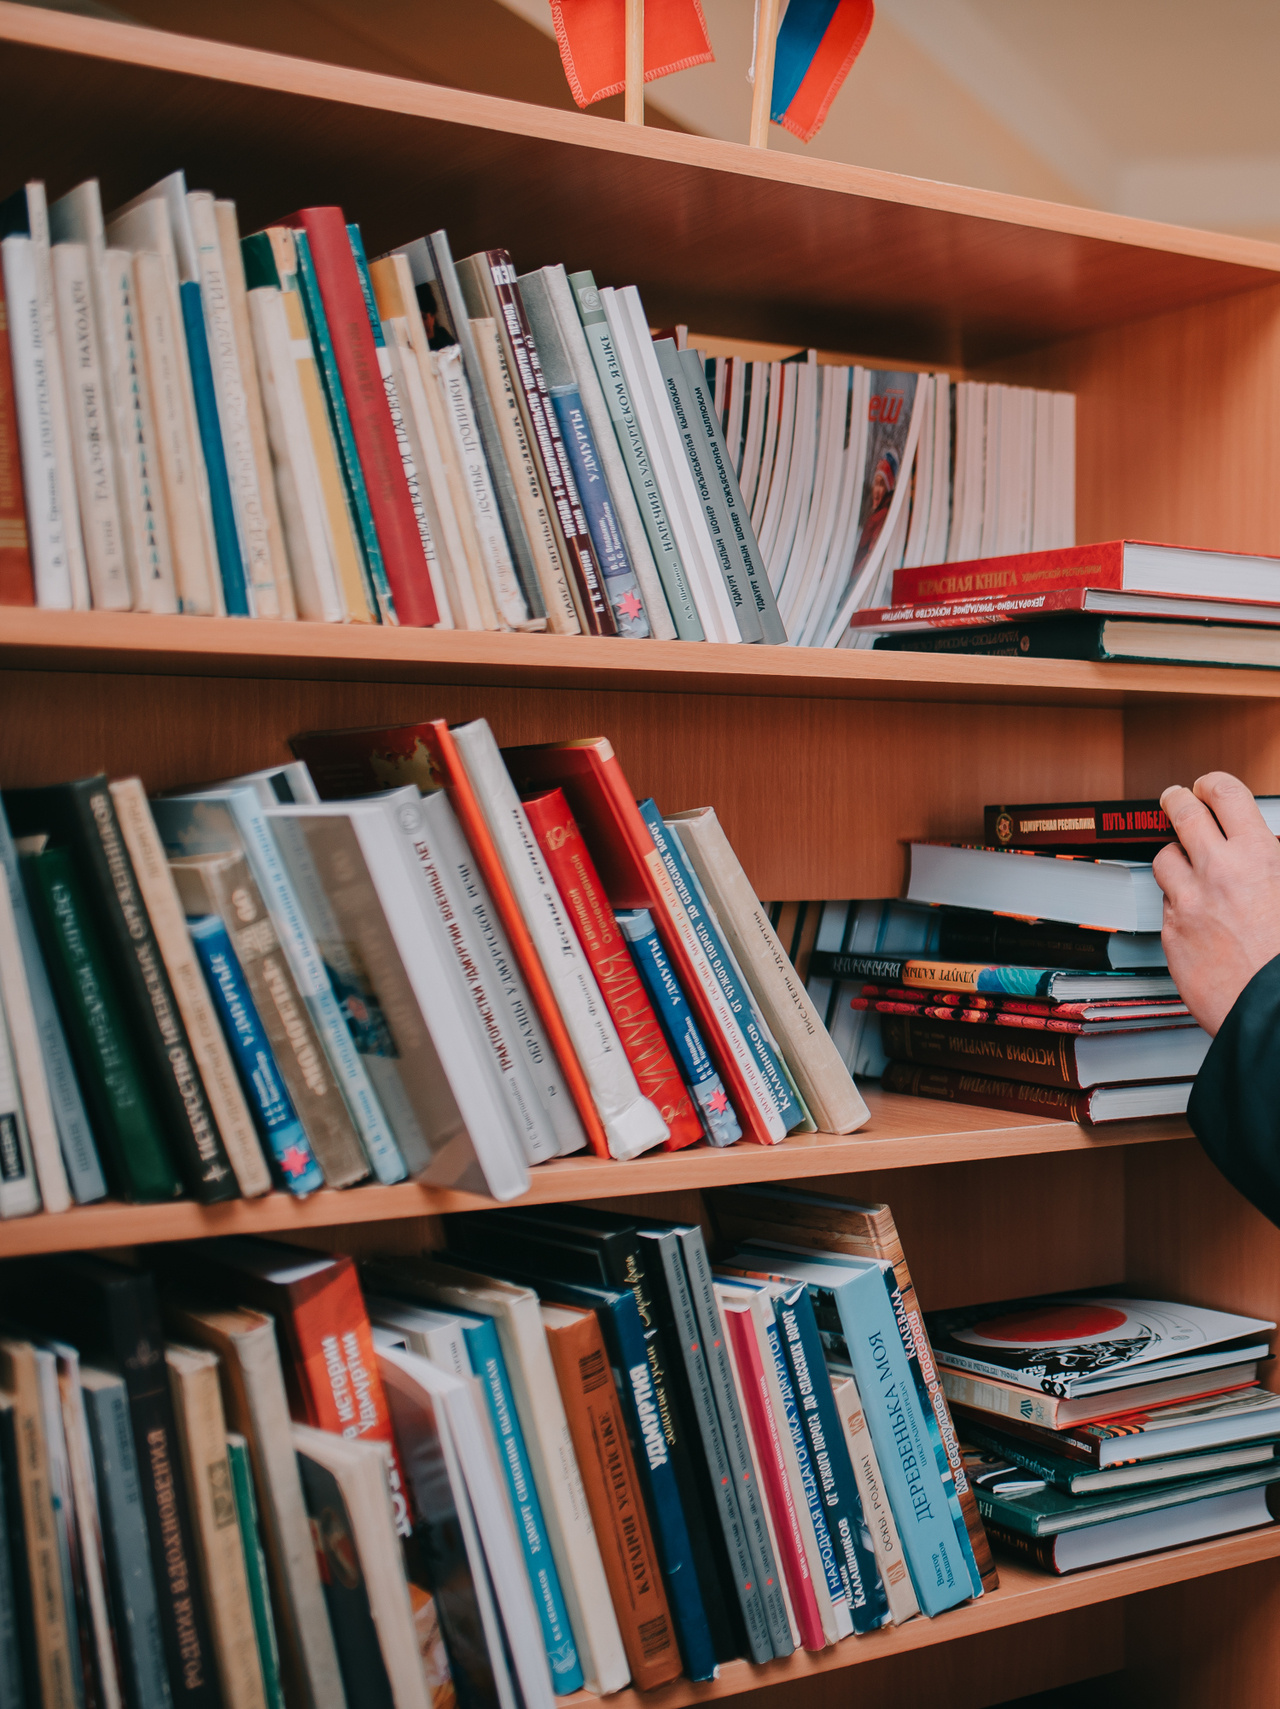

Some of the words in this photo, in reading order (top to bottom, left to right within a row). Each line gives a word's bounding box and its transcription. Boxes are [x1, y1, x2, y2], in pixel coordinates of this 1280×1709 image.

[30, 299, 42, 348] ПОЭМА
[70, 282, 90, 367] НАХОДКИ
[502, 302, 521, 336] ПЕРИОД
[514, 346, 536, 390] УДМУРТИИ
[601, 337, 620, 377] ЯЗЫКЕ
[36, 360, 52, 457] УДМУРТСКАЯ
[381, 375, 408, 445] ПАСЕКА
[541, 395, 560, 438] ПОЛИТИКИ
[667, 378, 688, 429] КЫЛЛЮКАМ
[695, 387, 714, 437] КЫЛЛЮКАМ
[83, 386, 107, 499] ГЛАЗОВСКИЕ
[526, 390, 563, 487] ПРЕДПРИНИМАТЕЛЬСТВО
[570, 410, 599, 482] УДМУРТЫ
[615, 383, 648, 475] УДМУРТСКОМ
[514, 415, 539, 497] ОБЕЛИСК
[553, 440, 579, 506] ЭКОНОМИЧЕСКОЙ
[684, 434, 710, 500] ГОЖЪЯСЬКОНЪЯ
[710, 442, 735, 507] ГОЖЪЯСЬКОНЪЯ
[405, 473, 435, 562] ПЧЕЛОВОД
[539, 509, 560, 570] ЕВГЕНЬЕВ
[556, 497, 577, 538] ТОРГОВЛЯ
[571, 507, 587, 535] НОВОЙ
[603, 502, 621, 551] Христолюбова
[648, 492, 673, 551] НАРЕЧИЯ
[706, 506, 720, 534] ШОНЕР
[731, 512, 744, 540] ШОНЕР
[716, 539, 731, 570] КЫЛЫН
[741, 545, 755, 576] КЫЛЫН
[919, 575, 973, 593] КРАСНАЯ
[976, 572, 1017, 589] КНИГА
[1021, 568, 1061, 583] УДМУРТСКОЙ
[1061, 563, 1102, 576] РЕСПУБЛИКИ
[558, 576, 575, 618] ПАВЕЛ
[727, 575, 742, 607] УДМУРТ
[751, 581, 765, 612] УДМУРТ
[880, 608, 914, 622] УДМУРТИИ
[914, 605, 951, 619] ИСКУССТВО
[952, 595, 1046, 615] ДЕКОРАТИВНО-ПРИКЛАДНОЕ
[647, 820, 668, 852] ВОРОТ
[1019, 819, 1057, 833] УДМУРТСКАЯ
[1057, 817, 1095, 830] РЕСПУБЛИКА
[1102, 812, 1125, 830] ПУТЬ
[1126, 812, 1133, 829] К
[415, 842, 430, 860] ЛЕТ
[512, 810, 545, 884] встречи
[424, 865, 453, 921] ВОЕННЫХ
[459, 865, 478, 897] РЕЧИ
[567, 854, 612, 943] Отечественной
[654, 863, 676, 907] ЛЕГЕНДЫ
[662, 851, 692, 904] СПАССКИХ
[545, 894, 572, 955] Лесные
[569, 889, 596, 940] Великой
[688, 905, 700, 919] ДО
[448, 923, 478, 983] УДМУРТИИ
[473, 904, 517, 995] УДМУРТСКОЙ
[682, 924, 698, 955] МИФЫ
[696, 922, 717, 959] ПОРОГА
[754, 912, 785, 972] УДМУРТИИ
[578, 975, 596, 1016] Фролов
[648, 939, 681, 1005] УДМУРТЫ
[699, 959, 719, 1000] СКАЗКИ,
[713, 960, 734, 998] ЧУЖОГО
[903, 966, 935, 979] КАЛЫК
[939, 968, 976, 983] УДМУРТ
[179, 964, 211, 1037] СОВЕТСКОЙ
[589, 948, 686, 1095] УДМУРТИЯ
[731, 999, 742, 1012] ОТ
[785, 977, 815, 1035] ПИСАТЕЛИ
[472, 986, 512, 1071] ТРАКТОРИСТКИ
[512, 1001, 543, 1063] ОБРАЗЦЫ
[596, 1022, 612, 1052] Юрий
[720, 1007, 745, 1057] НАРОДНЫЕ
[950, 1038, 1003, 1058] УДМУРТИИ
[748, 1024, 791, 1110] КАЛАШНИКОВ
[1007, 1048, 1055, 1066] ИСТОРИЯ
[166, 1044, 219, 1161] ИСКУССТВО
[204, 1042, 240, 1123] УДМУРТСКОЙ
[745, 1063, 773, 1121] УДМУРТСКИЕ
[959, 1077, 1013, 1098] УДМУРТИИ
[1018, 1086, 1068, 1107] ИСТОРИЯ
[781, 1309, 801, 1342] ВОРОТ
[888, 1287, 918, 1360] КАЛЕВАЛА
[904, 1310, 936, 1382] Победой!
[320, 1333, 357, 1422] истории
[767, 1329, 796, 1409] УДМУРТОВ
[789, 1342, 813, 1395] СПАССКИХ
[869, 1331, 892, 1381] МОЯ
[340, 1329, 379, 1433] Удмуртии
[487, 1360, 511, 1435] КЫЛЛЮКАМ
[724, 1383, 736, 1421] НАРОДНАЯ
[760, 1375, 768, 1397] МИРА
[802, 1394, 818, 1410] ДО
[927, 1383, 939, 1393] с
[627, 1362, 670, 1470] УДМУРТИЯ
[702, 1387, 714, 1425] НАРОДНАЯ
[900, 1381, 920, 1443] РАДИОПЕРЕДАЧ
[929, 1391, 963, 1468] вернулись
[711, 1428, 724, 1474] УДМУРТСКАЯ
[733, 1423, 746, 1470] УДМУРТСКАЯ
[764, 1397, 784, 1469] ФИННО-УГОРСКОГО
[806, 1412, 826, 1451] ПОРОГА
[885, 1382, 934, 1522] ДЕРЕВЕНЬКА
[917, 1444, 927, 1466] ЦИКЛ
[506, 1438, 527, 1501] СИНОНИМ
[787, 1410, 820, 1507] ПЕДАГОГИКА
[816, 1451, 836, 1491] ЧУЖОГО
[861, 1455, 881, 1509] РОДИНА!
[951, 1466, 970, 1495] Мы
[145, 1427, 191, 1594] ВДОХНОВЕНИЯ
[781, 1470, 792, 1506] СТОЛИЦА
[826, 1492, 839, 1506] ОТ
[521, 1507, 540, 1554] УДМУРТ
[788, 1505, 803, 1553] КУЛЬТУРНАЯ
[812, 1508, 839, 1589] НАРОДНАЯ
[878, 1511, 893, 1551] ОСКЫ,
[835, 1517, 867, 1608] КАЛАШНИКОВ
[932, 1554, 944, 1586] Виктор
[939, 1542, 955, 1588] Макшаков
[539, 1570, 556, 1623] КЕЛЬМАКОВ
[174, 1598, 201, 1688] РОДНИК
